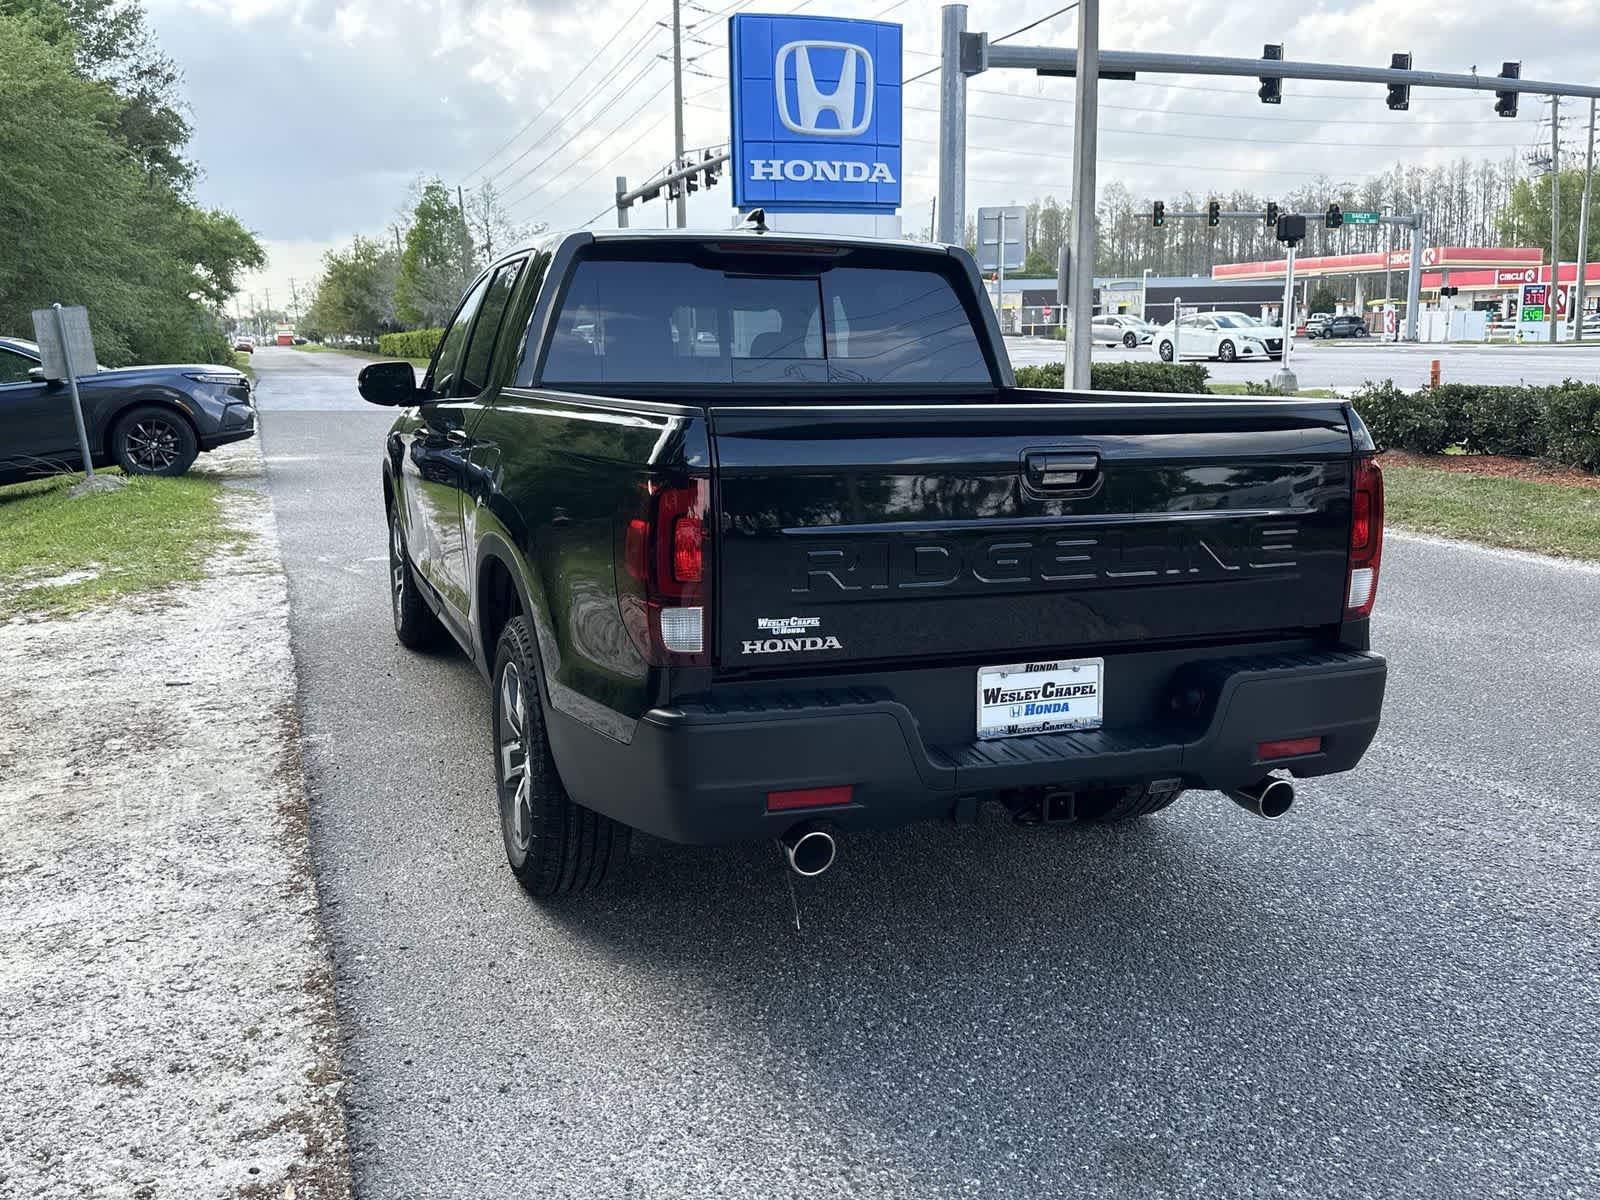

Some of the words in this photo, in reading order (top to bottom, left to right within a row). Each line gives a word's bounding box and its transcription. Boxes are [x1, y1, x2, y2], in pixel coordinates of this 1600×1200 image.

[750, 159, 897, 184] HONDA
[1387, 252, 1411, 265] CIRC
[1423, 249, 1435, 264] K
[1499, 272, 1525, 281] CIRCLE
[1526, 271, 1534, 281] K
[1386, 310, 1395, 333] 3
[791, 526, 1299, 593] RIDGELINE
[741, 636, 843, 654] HONDA
[1025, 663, 1058, 673] HONDA
[983, 687, 1040, 705] WESLEY
[1041, 682, 1096, 699] CHAPEL
[1024, 702, 1070, 716] HONDA
[1007, 725, 1041, 734] WESLEY
[1040, 721, 1074, 732] CHAPEL
